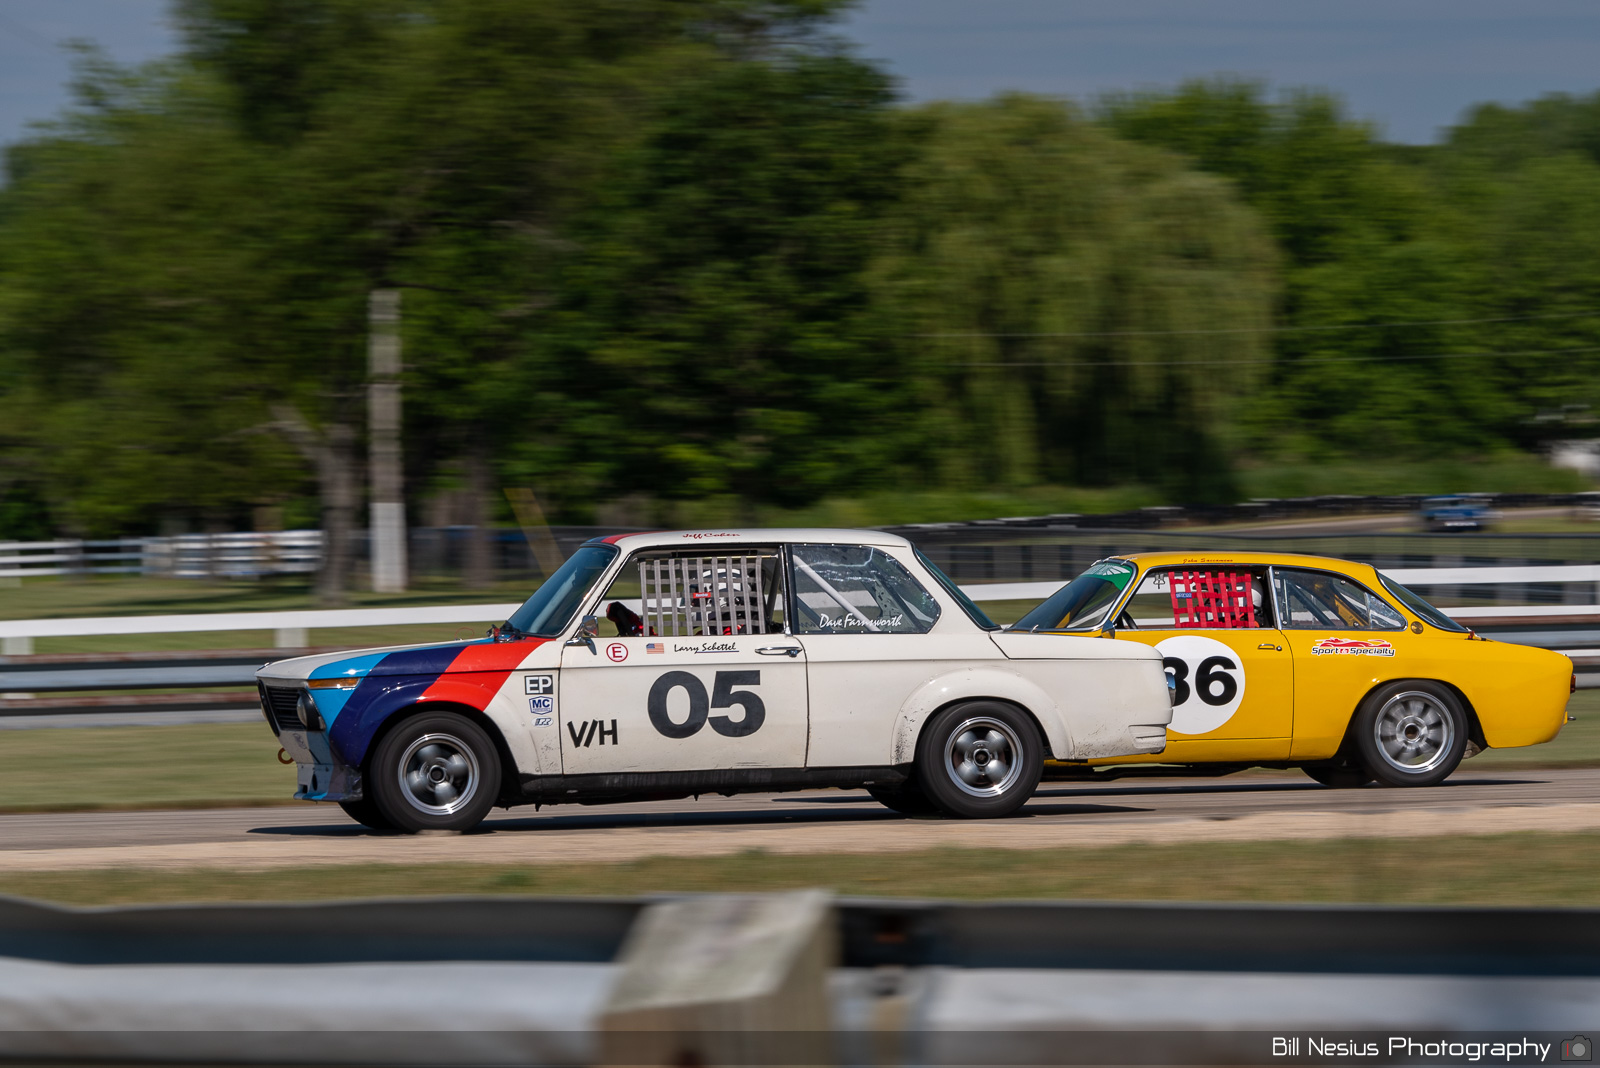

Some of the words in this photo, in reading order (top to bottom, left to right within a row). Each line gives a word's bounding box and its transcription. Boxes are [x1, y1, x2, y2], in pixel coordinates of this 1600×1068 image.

[819, 613, 843, 630] Dave
[674, 644, 700, 654] Larry
[702, 642, 736, 652] Schettel
[1350, 648, 1395, 656] Specialty
[526, 676, 552, 694] EP
[532, 699, 550, 708] MC
[648, 670, 766, 738] 05
[567, 719, 618, 748] V/H
